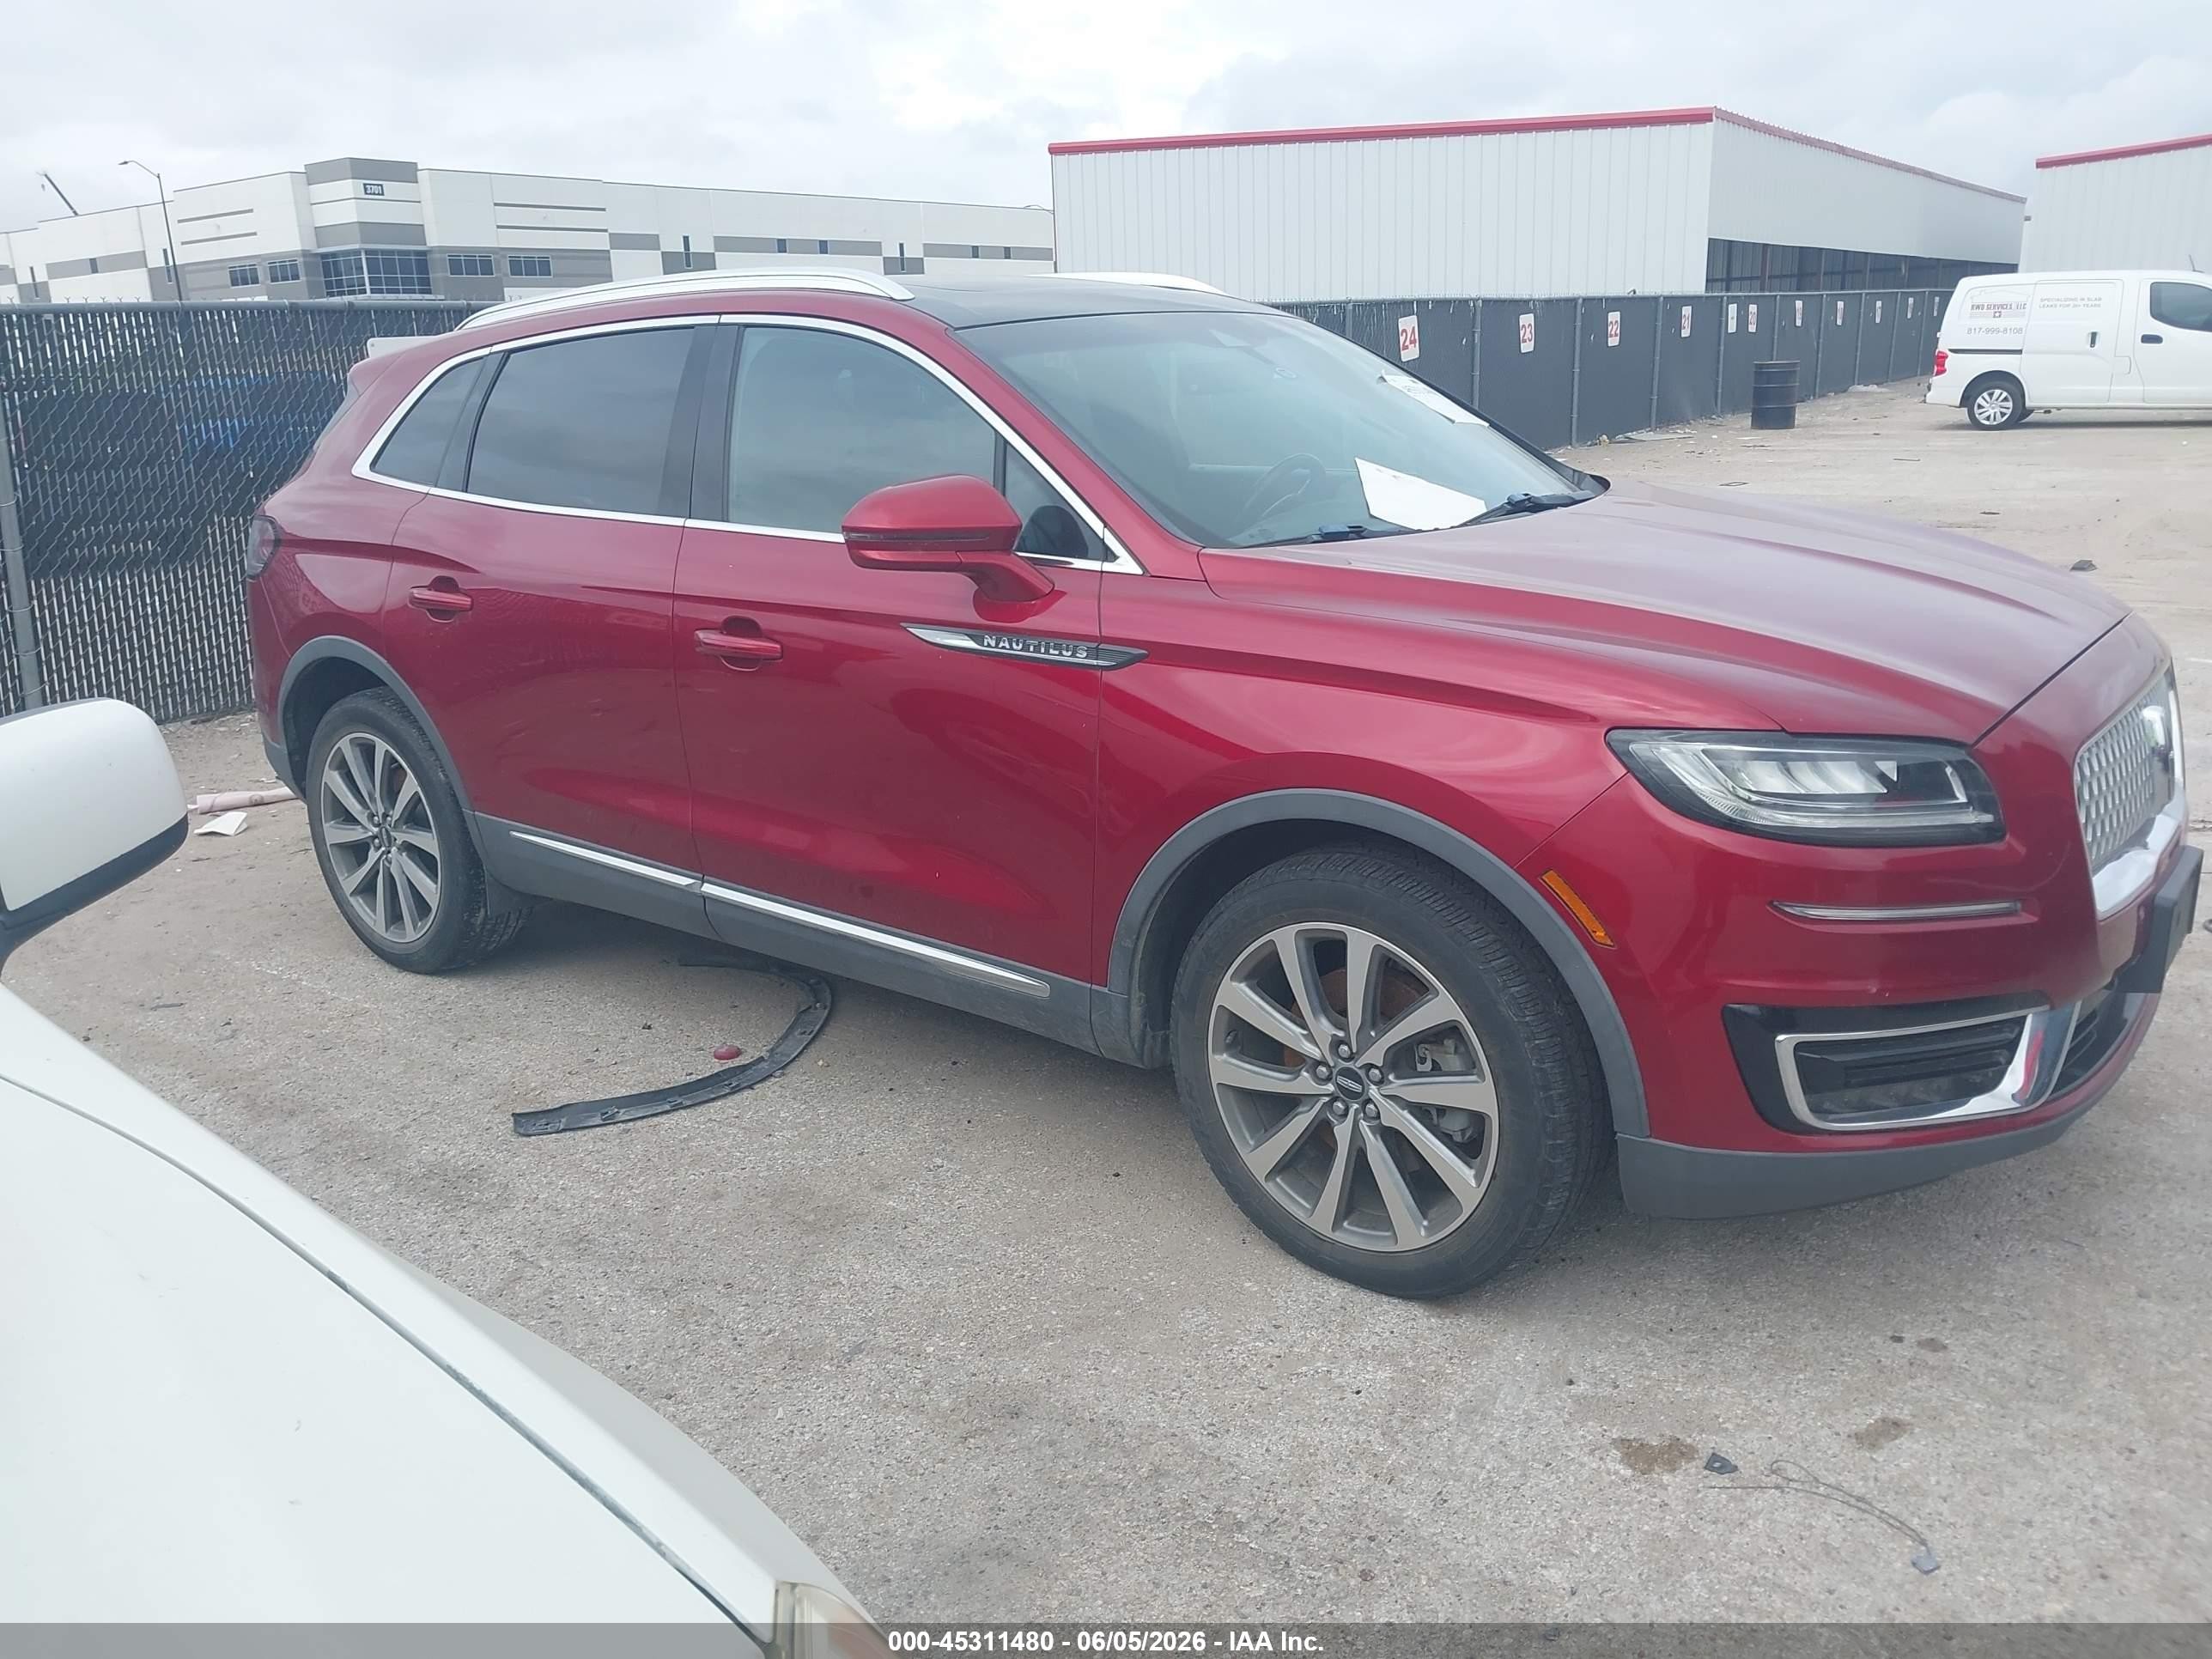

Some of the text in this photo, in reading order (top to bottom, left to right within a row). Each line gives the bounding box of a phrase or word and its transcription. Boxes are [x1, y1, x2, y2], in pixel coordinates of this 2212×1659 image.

[1608, 320, 1619, 338] 22
[1681, 313, 1690, 330] 21
[1400, 326, 1418, 351] 24
[1521, 323, 1534, 343] 23
[983, 635, 1088, 659] NAUTILUS
